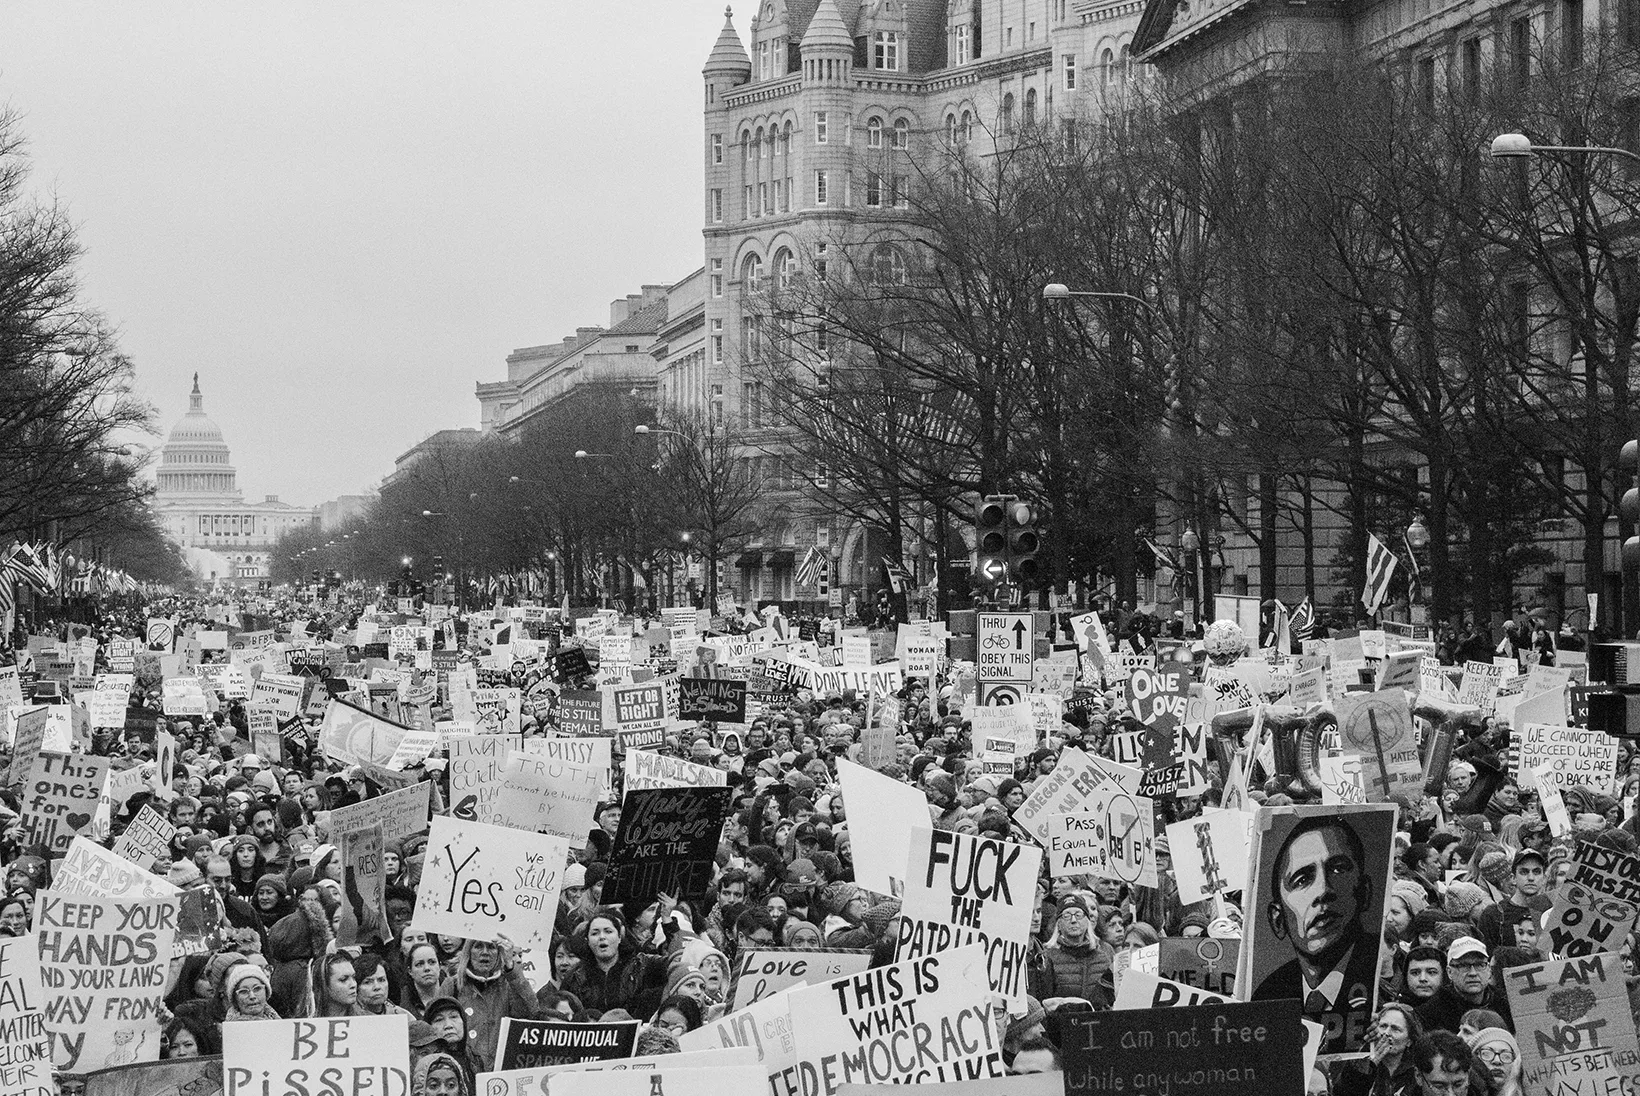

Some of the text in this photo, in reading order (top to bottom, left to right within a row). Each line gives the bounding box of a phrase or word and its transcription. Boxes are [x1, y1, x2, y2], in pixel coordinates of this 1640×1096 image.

[981, 617, 1007, 629] THRU
[242, 655, 266, 665] NEVER
[728, 644, 743, 657] NO
[907, 646, 936, 654] WOMAN
[980, 653, 1031, 665] OBEY THIS
[49, 662, 76, 670] PROTECT
[439, 661, 457, 669] STILL
[908, 664, 930, 672] ROAR
[980, 666, 1014, 677] SIGNAL
[1122, 658, 1150, 667] LOVE
[1466, 661, 1486, 674] KEEP
[255, 684, 300, 697] NASTY WOMEN
[682, 681, 745, 701] We Will NOT
[814, 671, 849, 695] DON'T
[1131, 669, 1180, 700] ONE
[1214, 678, 1241, 702] your
[1294, 678, 1318, 692] ENRAGED
[561, 698, 600, 709] THE FUTURE
[618, 689, 659, 706] LEFT OR
[760, 694, 790, 702] TRUST
[560, 708, 600, 722] IS STILL
[619, 702, 660, 721] RIGHT
[1131, 695, 1188, 726] LOVE
[560, 721, 601, 735] FEMALE
[642, 721, 652, 729] ALL
[622, 730, 664, 747] WRONG
[1527, 727, 1617, 747] WE CANNOT ALL
[1390, 749, 1419, 763] HATES
[1523, 743, 1612, 759] SUCCEED WHEN
[38, 751, 99, 779] This
[516, 756, 599, 786] TRUTH
[1553, 758, 1613, 772] OF US ARE
[34, 779, 100, 801] one's
[1070, 763, 1108, 799] ERA
[1566, 773, 1594, 786] BACK
[543, 788, 558, 799] be
[1023, 763, 1076, 821] OREGON'S
[30, 794, 70, 817] for
[537, 802, 556, 815] BY
[137, 806, 177, 841] BUILD
[1065, 817, 1096, 832] PASS
[124, 841, 146, 862] NOT
[633, 840, 692, 859] ARE THE
[1052, 836, 1098, 851] EQUAL
[514, 865, 556, 892] Still
[925, 829, 1021, 907] FUCK
[443, 843, 508, 923] Yes,
[613, 859, 712, 900] FUTURE
[1573, 864, 1618, 895] HAS
[39, 896, 176, 931] KEEP YOUR
[514, 893, 545, 914] can!
[950, 895, 984, 930] THE
[1561, 906, 1615, 944] ON
[38, 930, 158, 967] HANDS
[738, 951, 842, 977] Love is
[69, 963, 165, 990] YOUR LAWS
[831, 965, 905, 1016] THIS
[912, 956, 940, 995] IS
[1510, 955, 1607, 997] I AM
[103, 996, 164, 1021] FROM
[848, 998, 917, 1042] WHAT
[290, 1018, 351, 1062] BE
[518, 1027, 620, 1047] AS INDIVIDUAL
[1120, 1027, 1153, 1050] am
[1166, 1018, 1202, 1049] not
[1211, 1015, 1268, 1045] free
[1533, 1018, 1608, 1060] NOT
[798, 1001, 993, 1096] DEMOCRACY
[1068, 1067, 1124, 1091] while
[1524, 1053, 1582, 1087] WHAT'S
